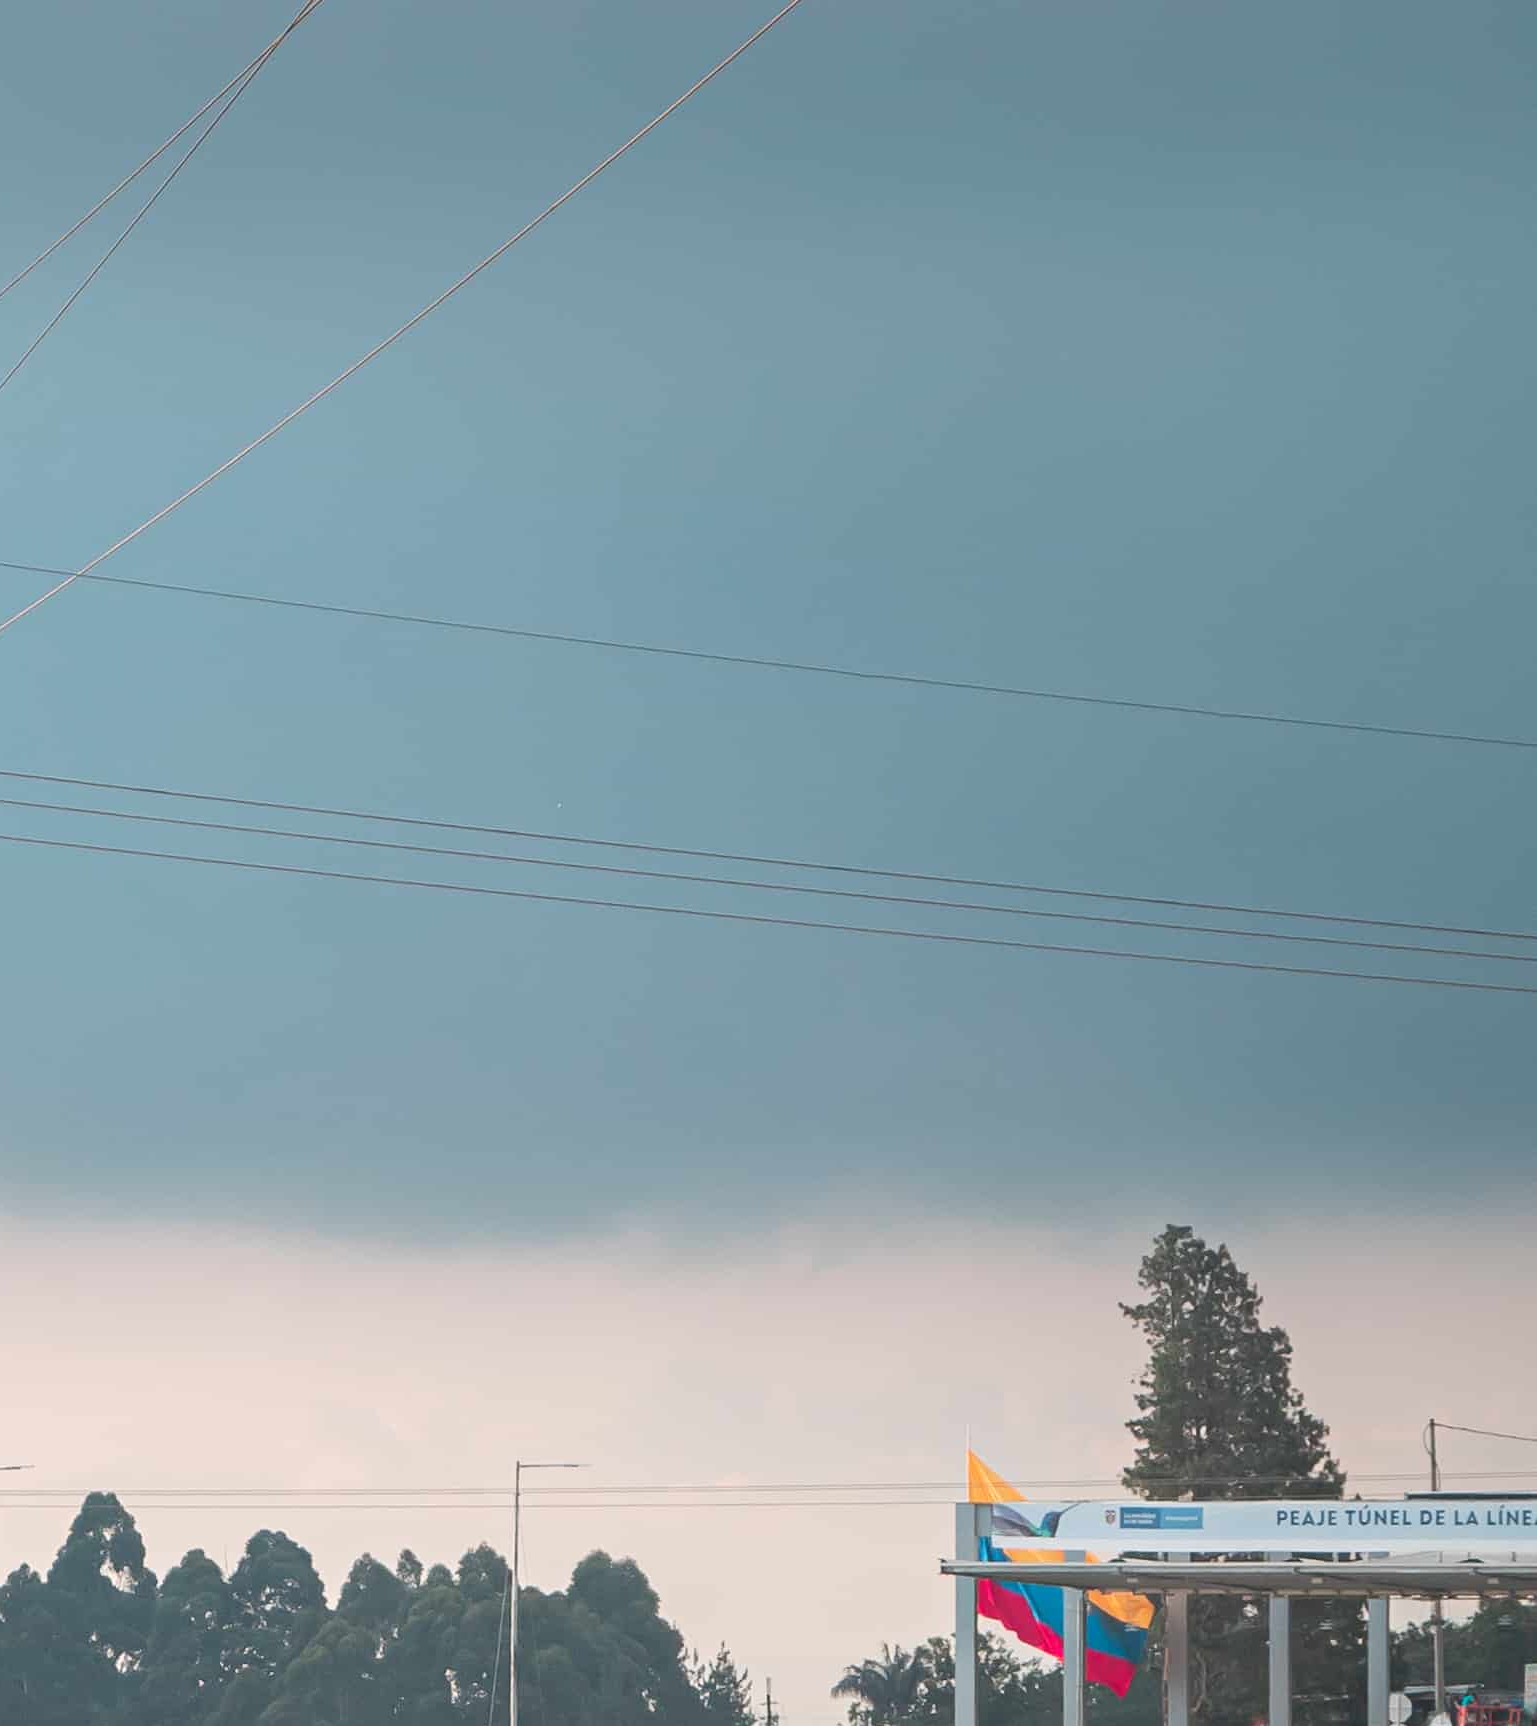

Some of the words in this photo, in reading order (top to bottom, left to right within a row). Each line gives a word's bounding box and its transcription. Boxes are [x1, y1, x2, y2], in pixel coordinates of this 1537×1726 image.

[1276, 1510, 1337, 1526] PEAJE
[1345, 1504, 1412, 1526] TÚNEL
[1420, 1510, 1446, 1526] DE
[1455, 1510, 1478, 1526] LA
[1487, 1504, 1537, 1526] LÍNE
